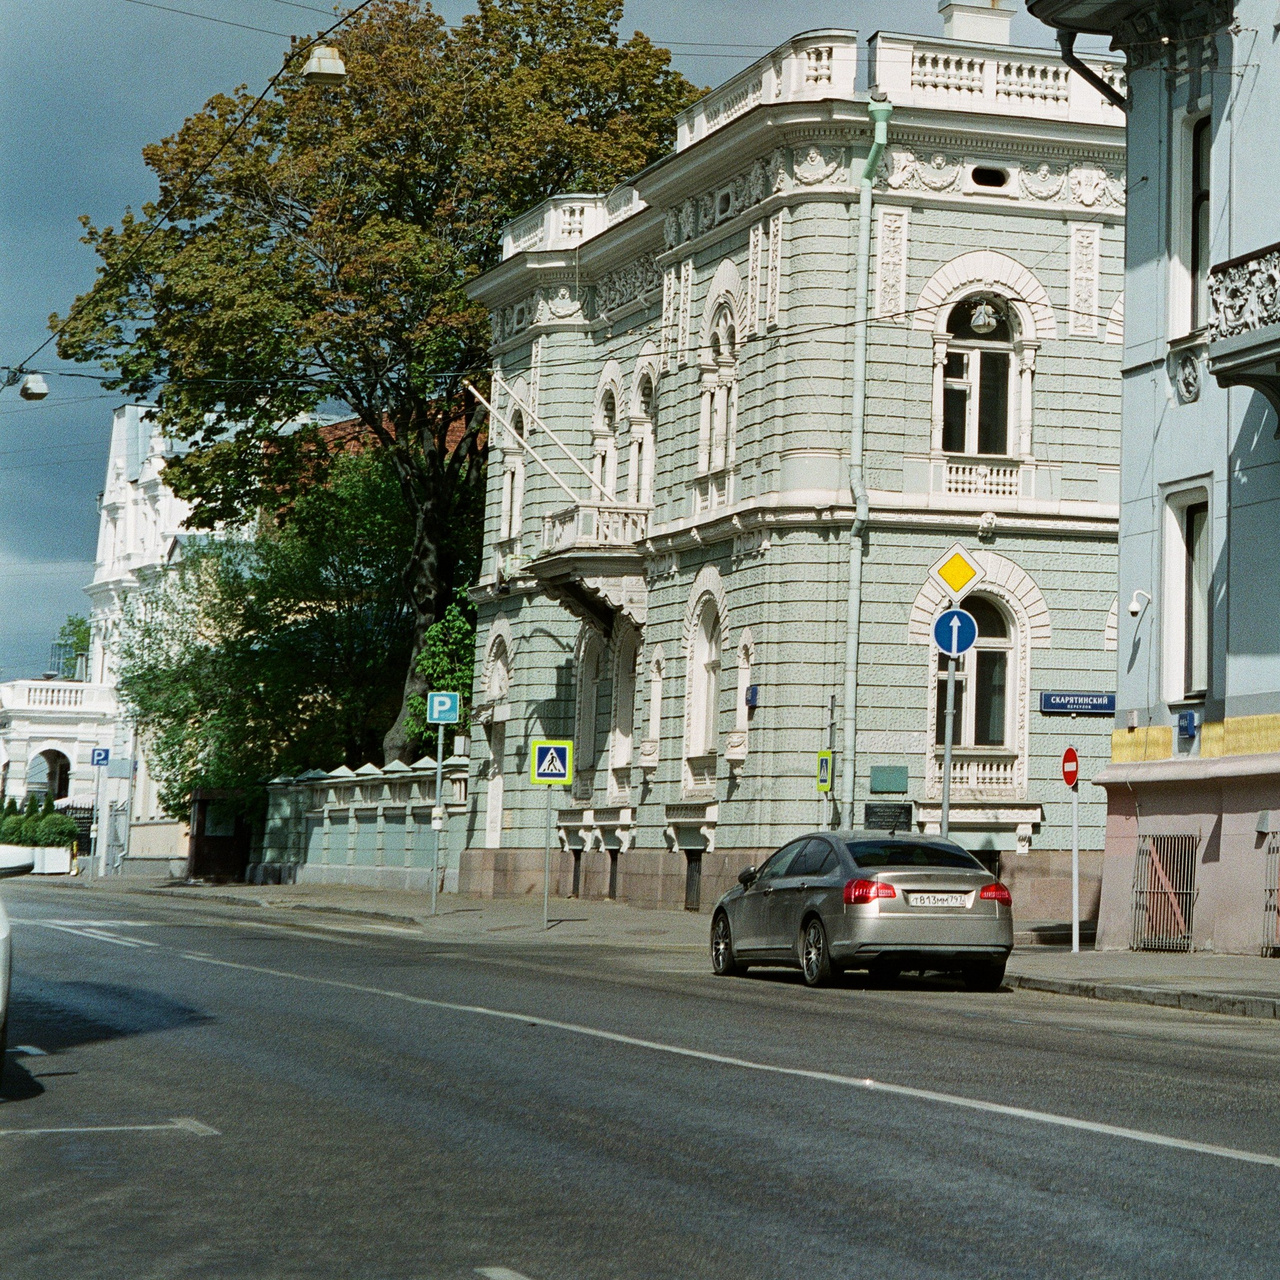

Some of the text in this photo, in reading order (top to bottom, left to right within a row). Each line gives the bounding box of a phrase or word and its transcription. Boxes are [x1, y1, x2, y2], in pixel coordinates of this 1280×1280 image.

[433, 696, 451, 719] P
[1050, 695, 1108, 705] СКАРЯТИНСКИЙ
[93, 750, 106, 765] P
